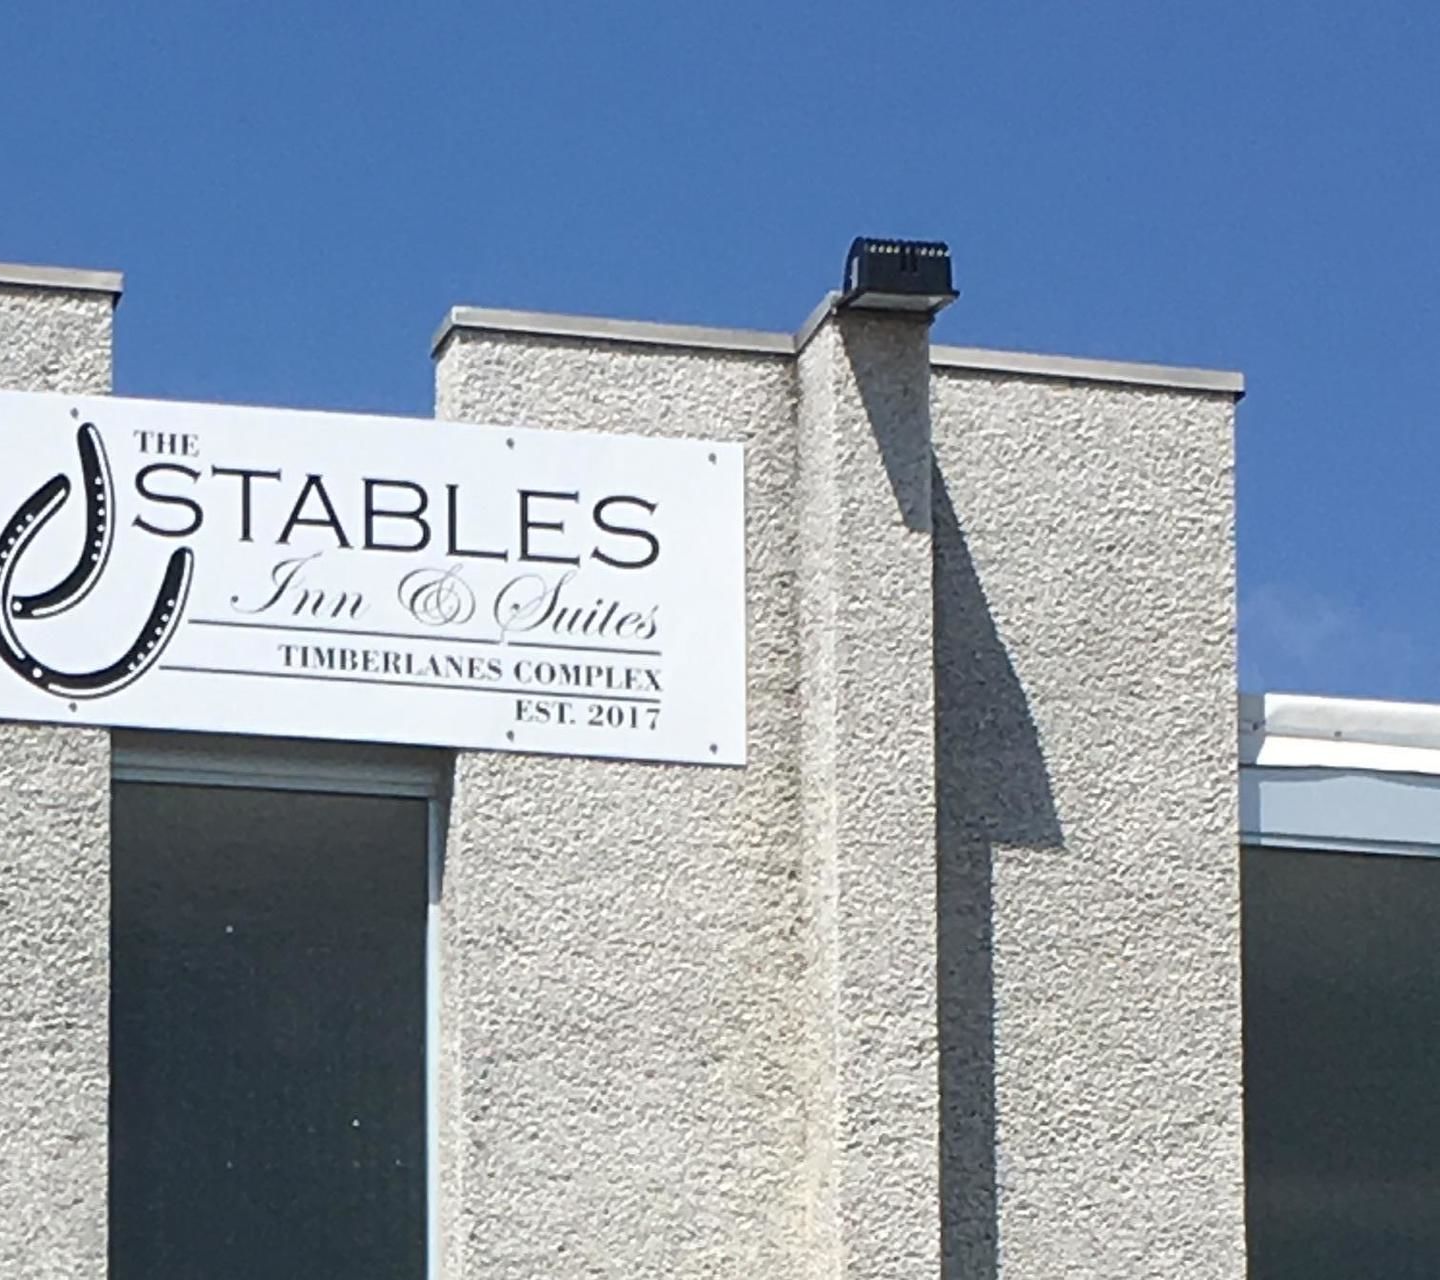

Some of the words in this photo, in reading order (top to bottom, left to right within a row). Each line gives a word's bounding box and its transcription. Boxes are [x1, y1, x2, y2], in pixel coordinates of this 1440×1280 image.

[133, 430, 200, 457] THE
[131, 462, 661, 570] STABLES
[230, 551, 368, 619] Inn
[397, 563, 477, 627] &
[493, 569, 659, 643] Suites
[277, 643, 503, 681] TIMBERLANES
[513, 660, 663, 692] COMPLEX
[514, 699, 577, 726] EST.
[587, 703, 661, 731] 2017
